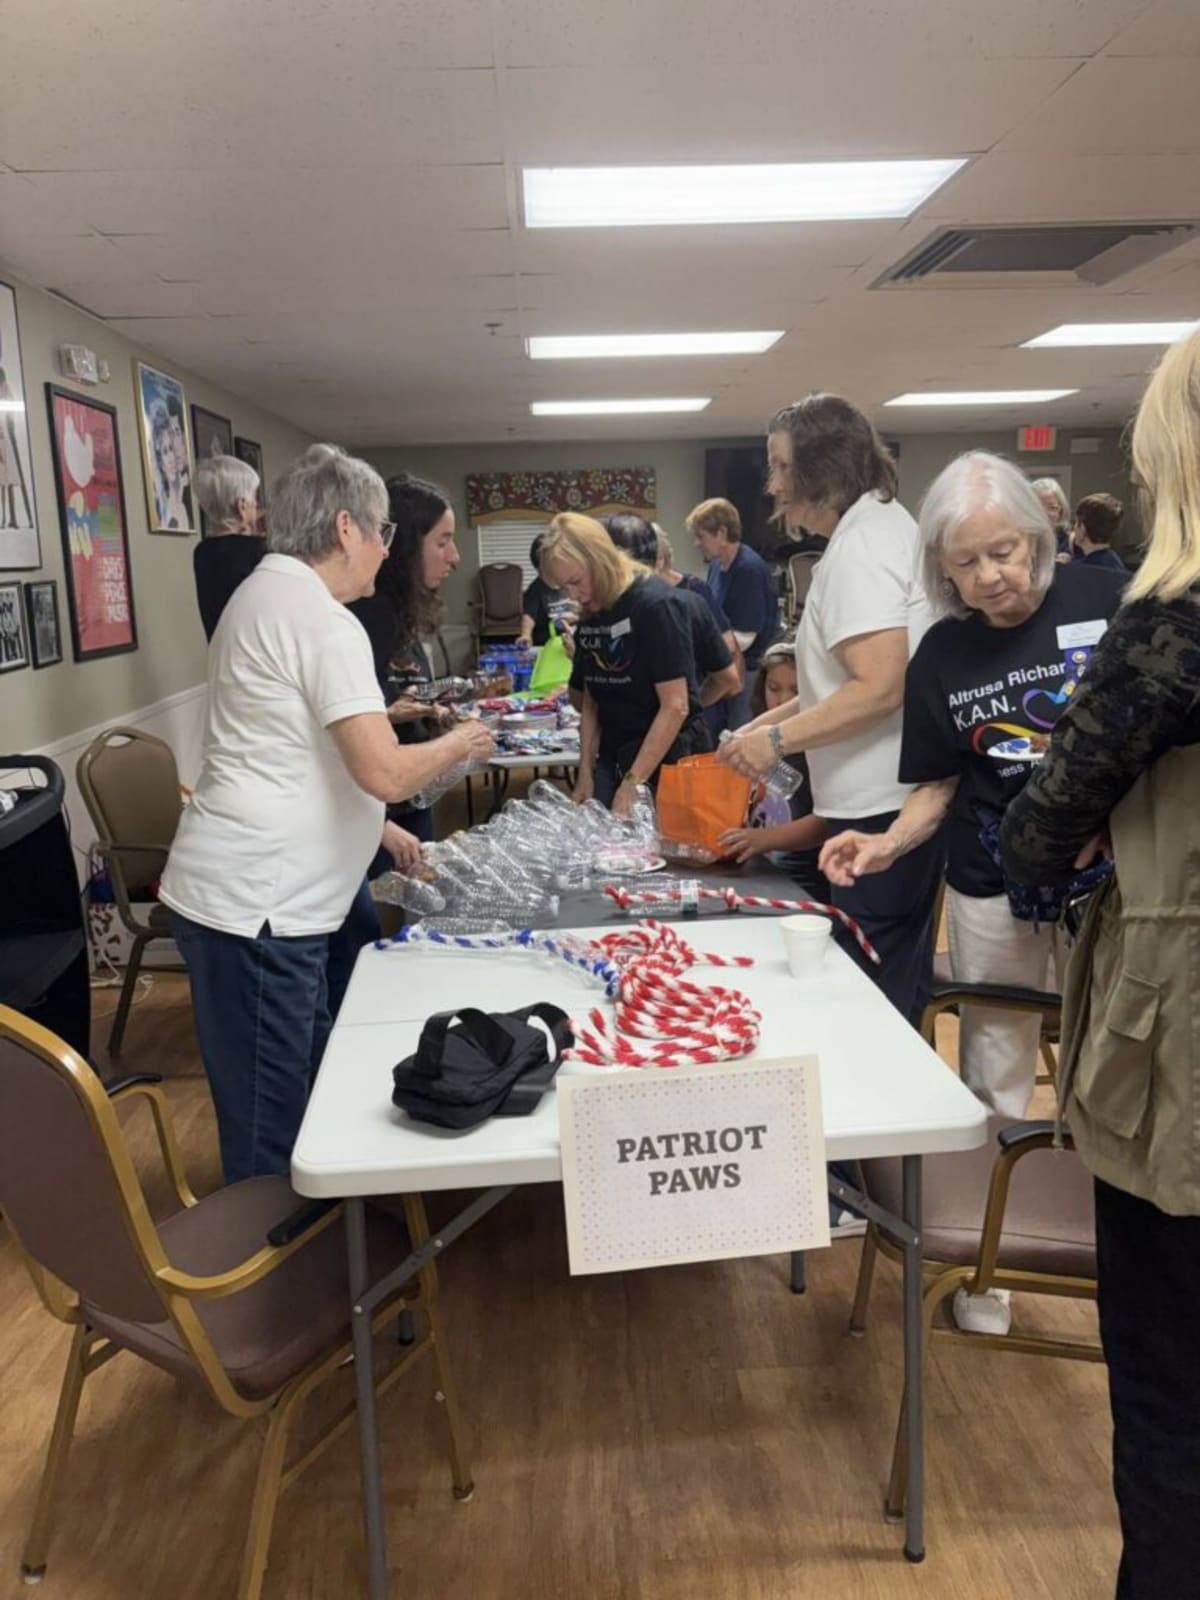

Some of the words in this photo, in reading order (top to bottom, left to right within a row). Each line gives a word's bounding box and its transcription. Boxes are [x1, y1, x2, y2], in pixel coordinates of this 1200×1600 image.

[948, 680, 1004, 709] Altrusa
[1007, 663, 1067, 687] Richar
[953, 695, 1017, 732] K.A.N.
[616, 1125, 767, 1163] PATRIOT
[648, 1162, 741, 1196] PAWS
